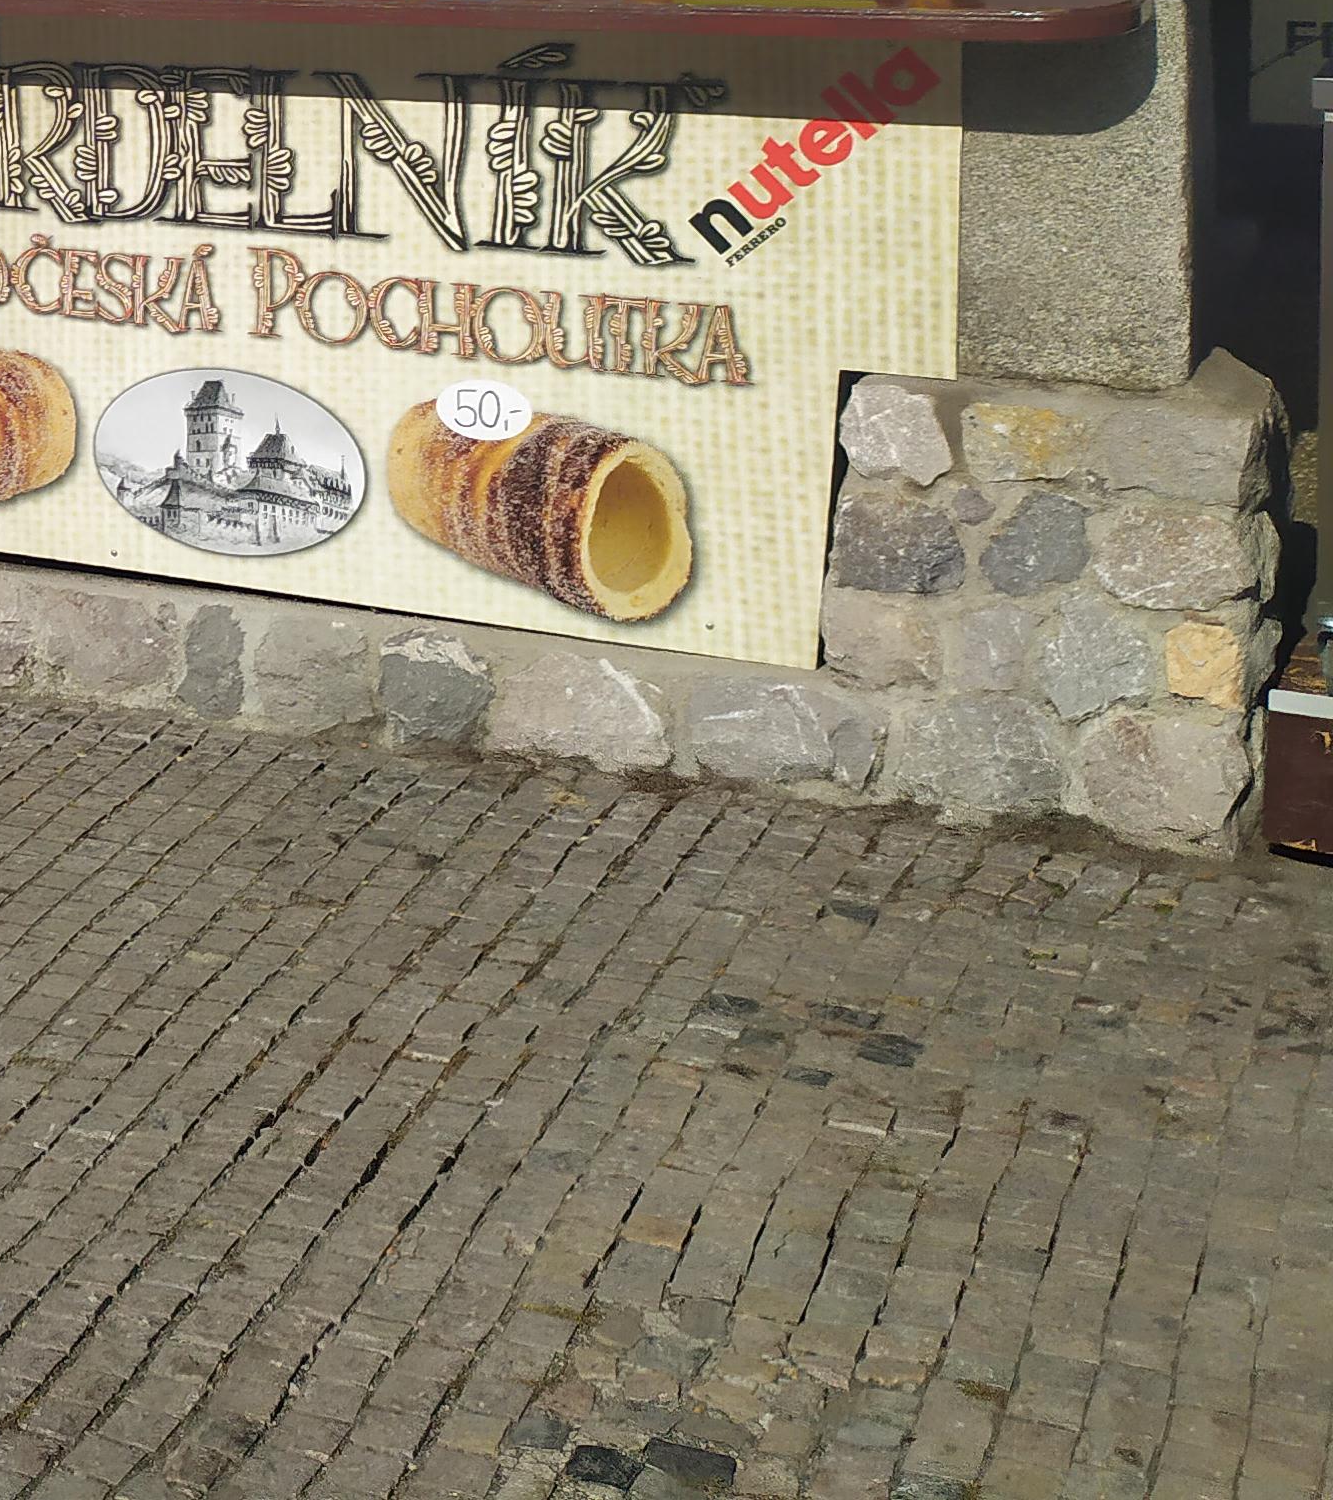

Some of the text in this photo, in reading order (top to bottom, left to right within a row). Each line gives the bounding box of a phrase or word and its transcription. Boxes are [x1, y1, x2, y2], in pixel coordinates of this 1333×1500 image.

[687, 45, 942, 256] nutella
[724, 216, 787, 269] FERRERO
[247, 245, 756, 389] POCHOUTKA
[453, 388, 523, 432] 50,-
